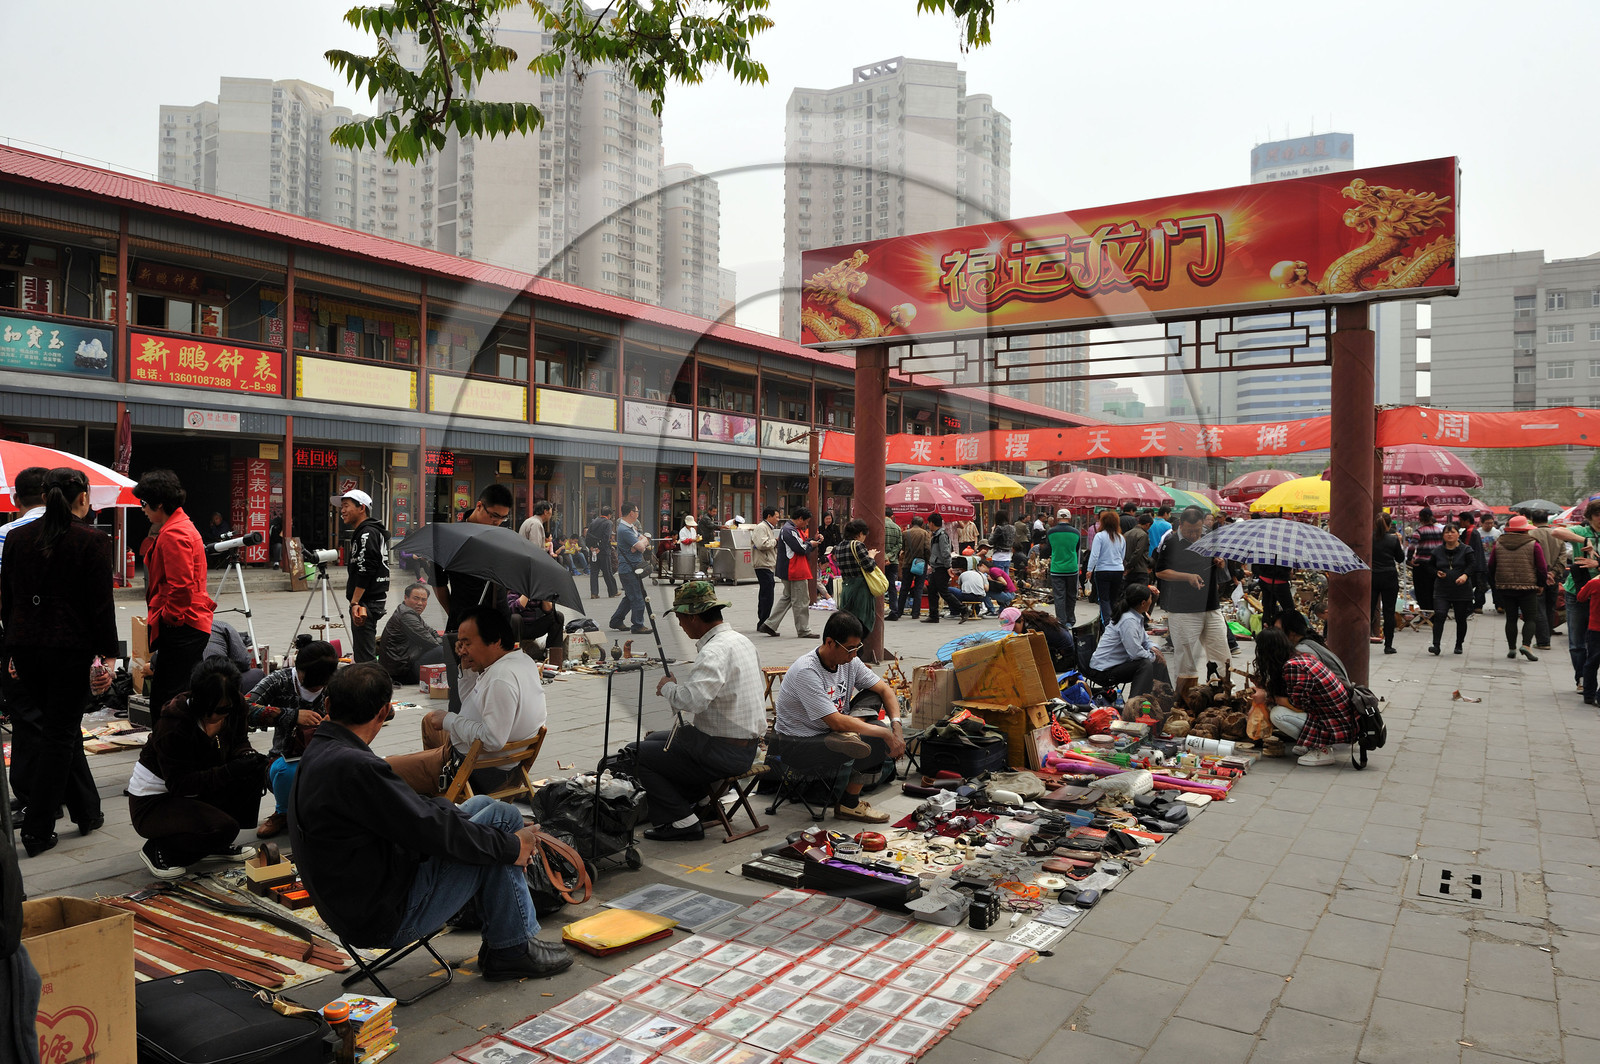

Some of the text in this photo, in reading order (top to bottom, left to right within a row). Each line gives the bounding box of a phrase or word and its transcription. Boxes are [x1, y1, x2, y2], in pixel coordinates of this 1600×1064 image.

[1280, 169, 1298, 177] NAN
[1302, 165, 1330, 174] PLAZA
[940, 213, 1224, 310] 福运龙门
[136, 338, 277, 381] 新鹏钟表
[169, 372, 231, 387] 13601087388
